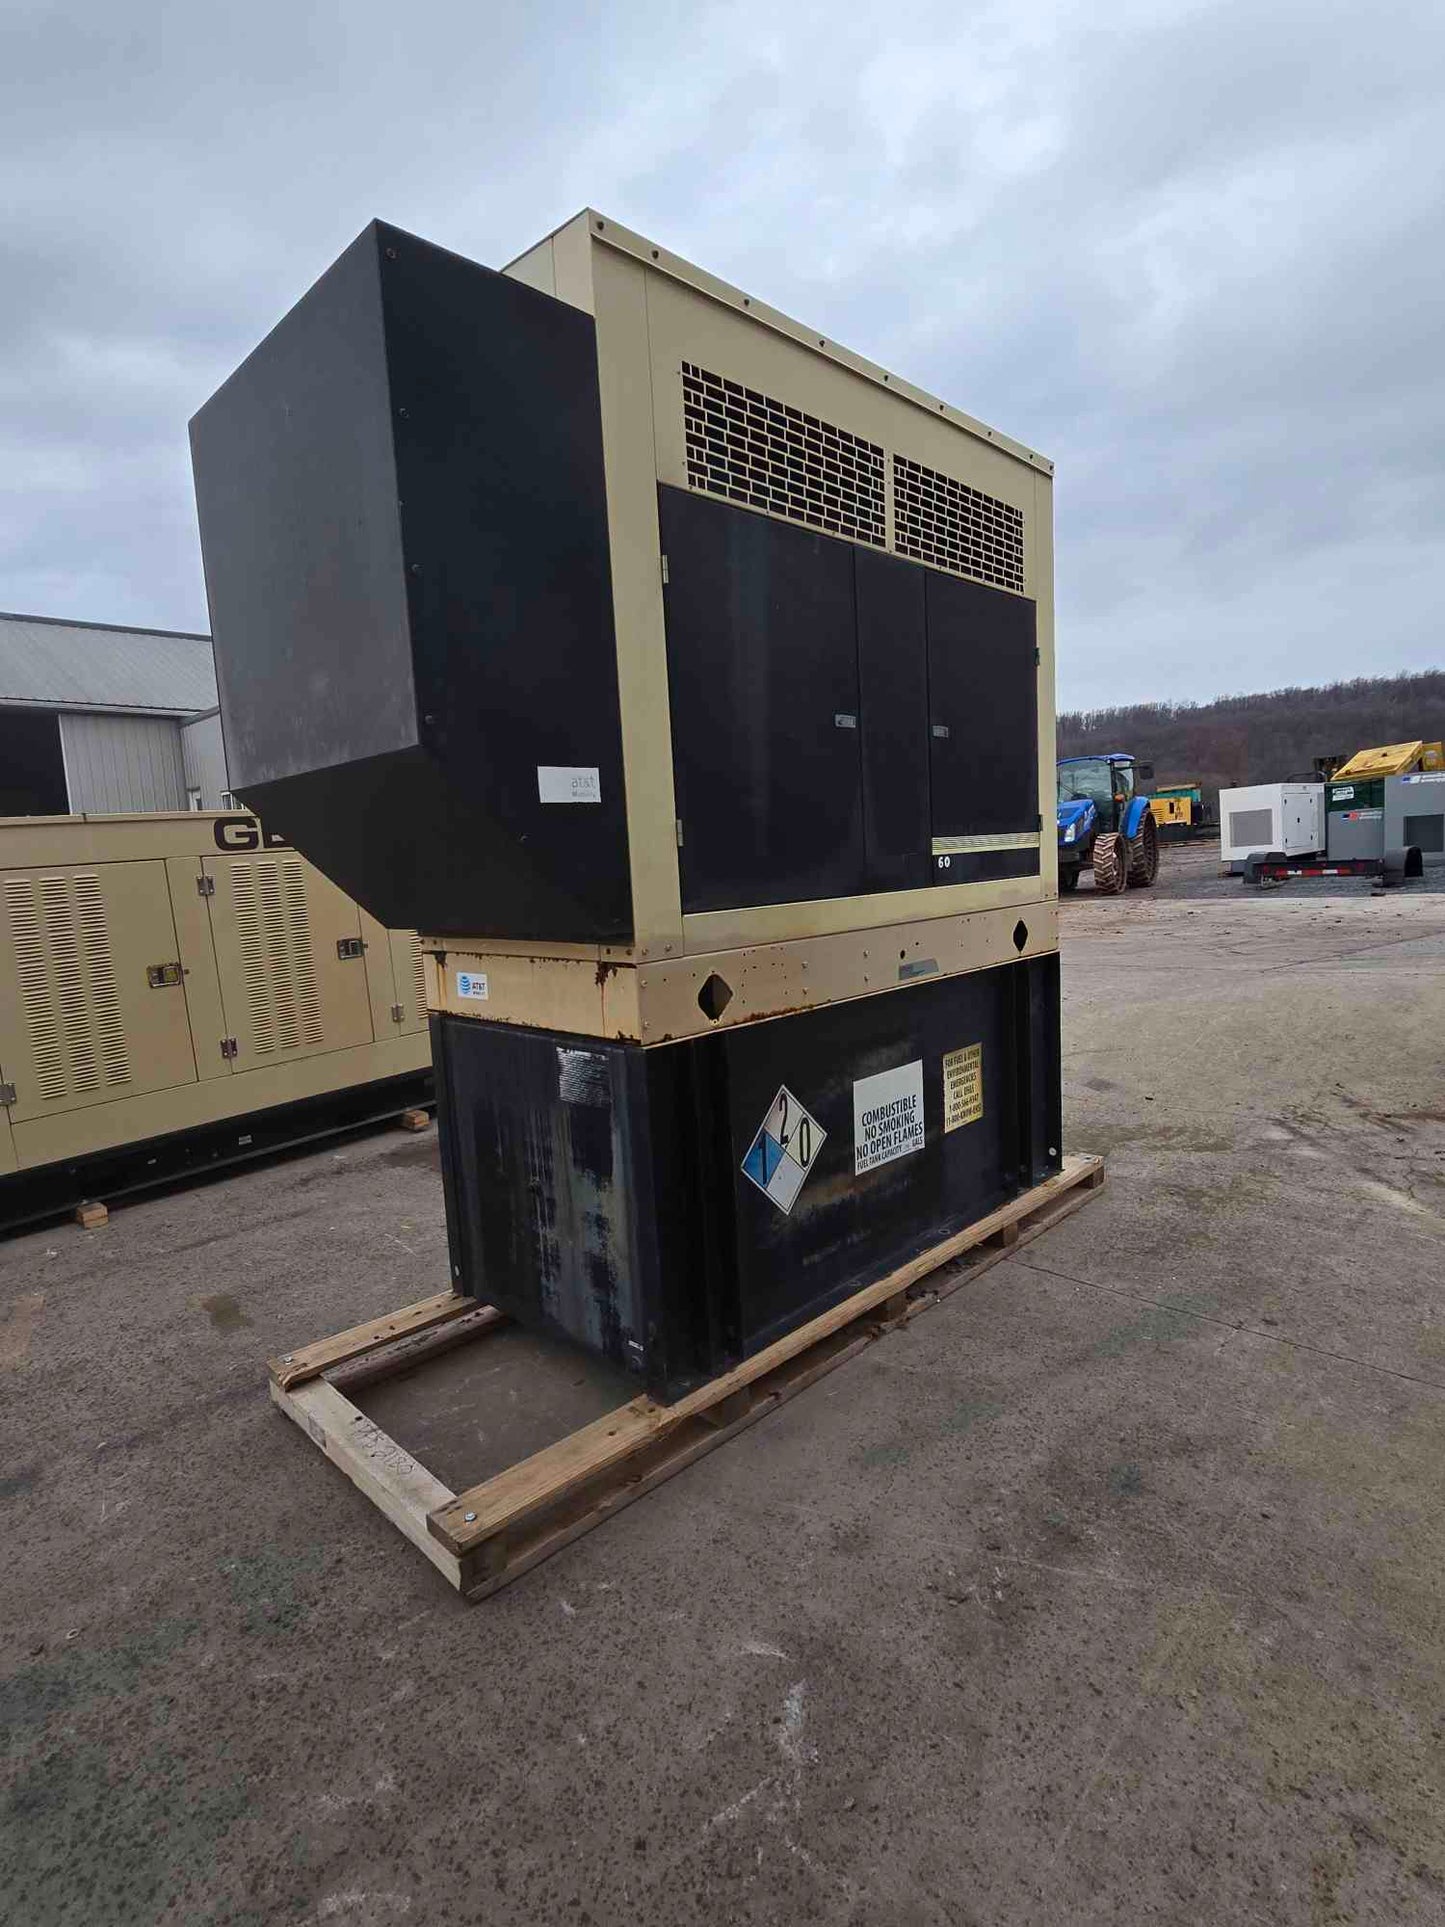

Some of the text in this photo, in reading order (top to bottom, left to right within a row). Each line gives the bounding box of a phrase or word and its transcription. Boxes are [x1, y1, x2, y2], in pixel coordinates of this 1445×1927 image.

[938, 856, 951, 869] 60
[779, 1093, 789, 1145] 2
[861, 1094, 917, 1127] COMBUSTIBLE
[865, 1110, 915, 1142] NO SMOKING
[800, 1117, 811, 1167] 0
[856, 1143, 869, 1161] NO
[870, 1133, 892, 1155] OPEN
[893, 1121, 923, 1146] FLAMES
[857, 1158, 869, 1171] FUEL
